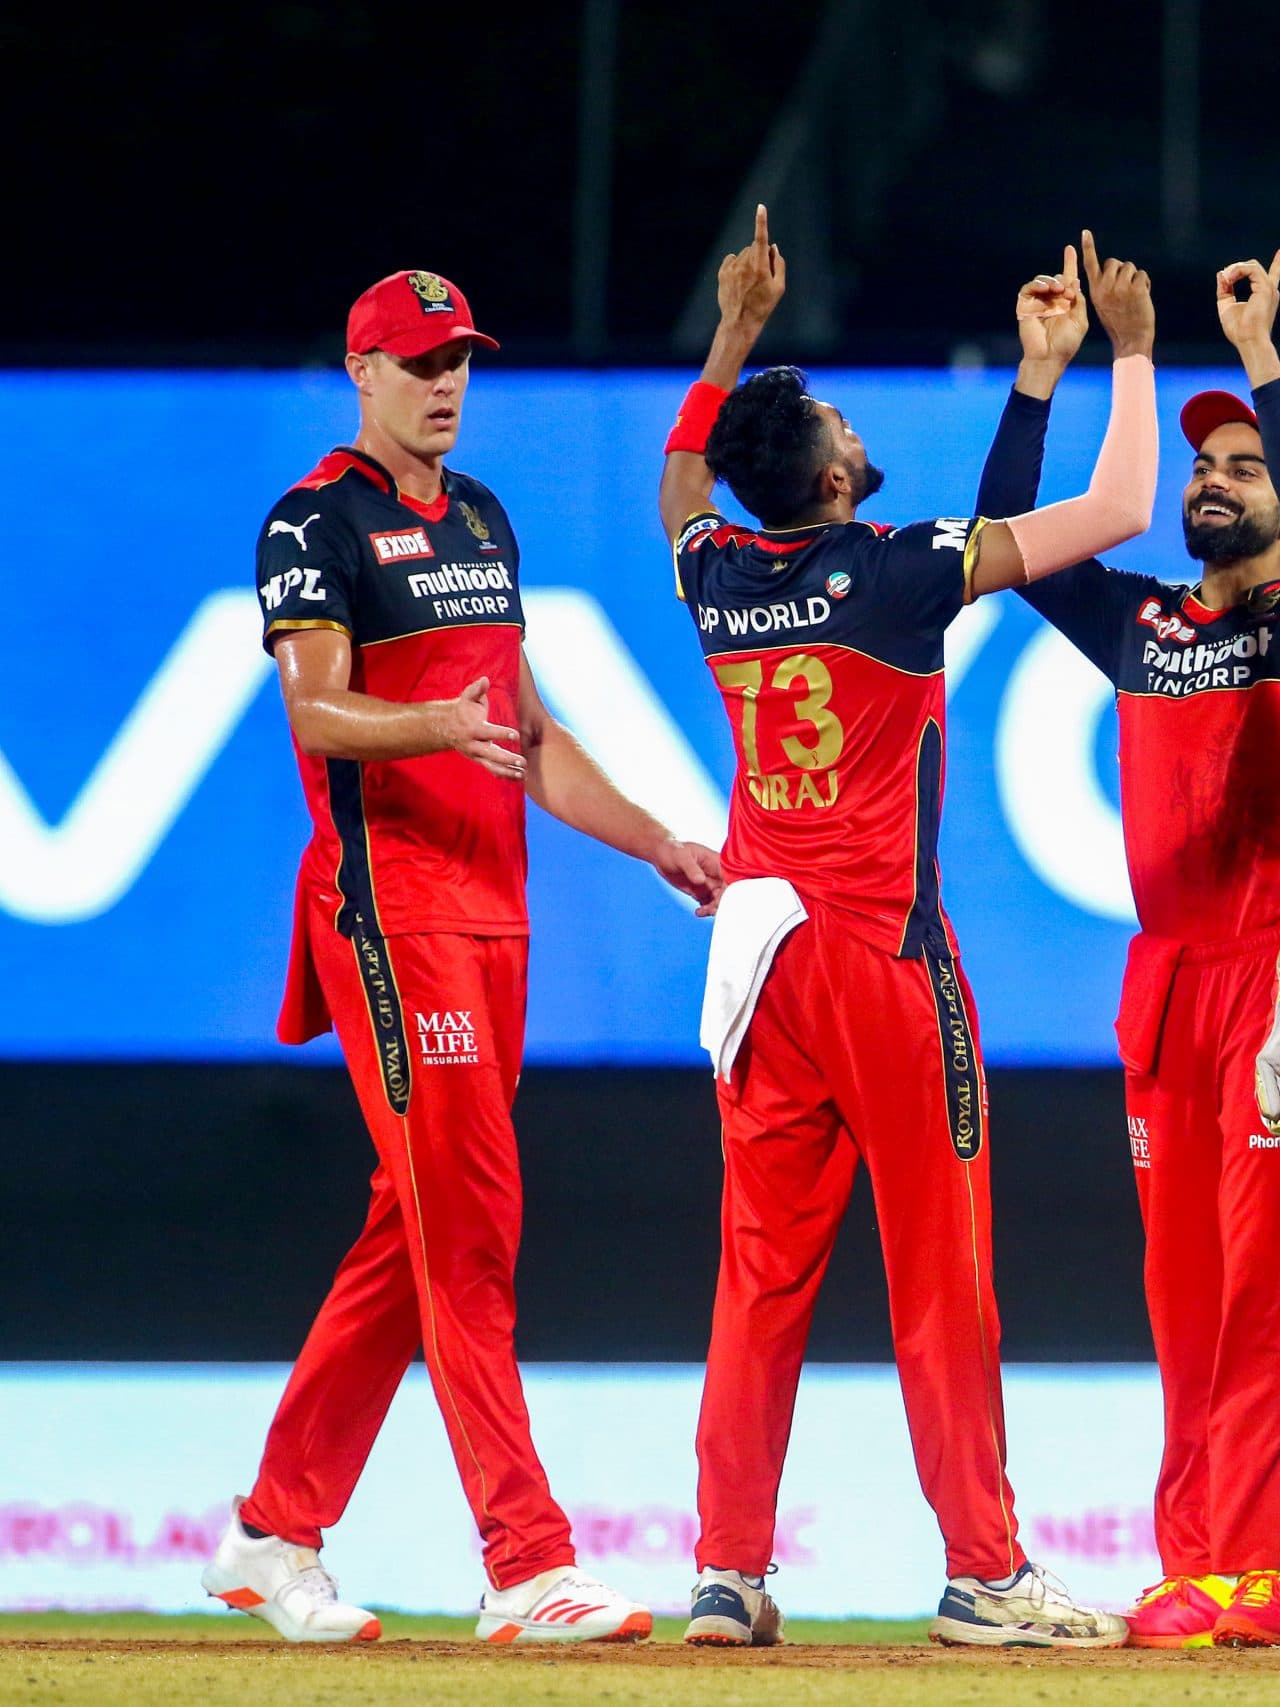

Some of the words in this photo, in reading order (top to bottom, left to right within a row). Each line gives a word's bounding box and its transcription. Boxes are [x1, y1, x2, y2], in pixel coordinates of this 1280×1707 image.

[374, 532, 430, 559] EXIDE
[408, 561, 513, 598] muthoot
[432, 596, 509, 619] FINCORP
[698, 603, 719, 634] DP
[723, 596, 831, 636] WORLD
[715, 654, 844, 777] 73
[415, 1011, 475, 1033] MAX
[419, 1032, 478, 1053] LIFE
[423, 1054, 480, 1065] INSURANCE
[956, 1080, 975, 1150] ROYAL
